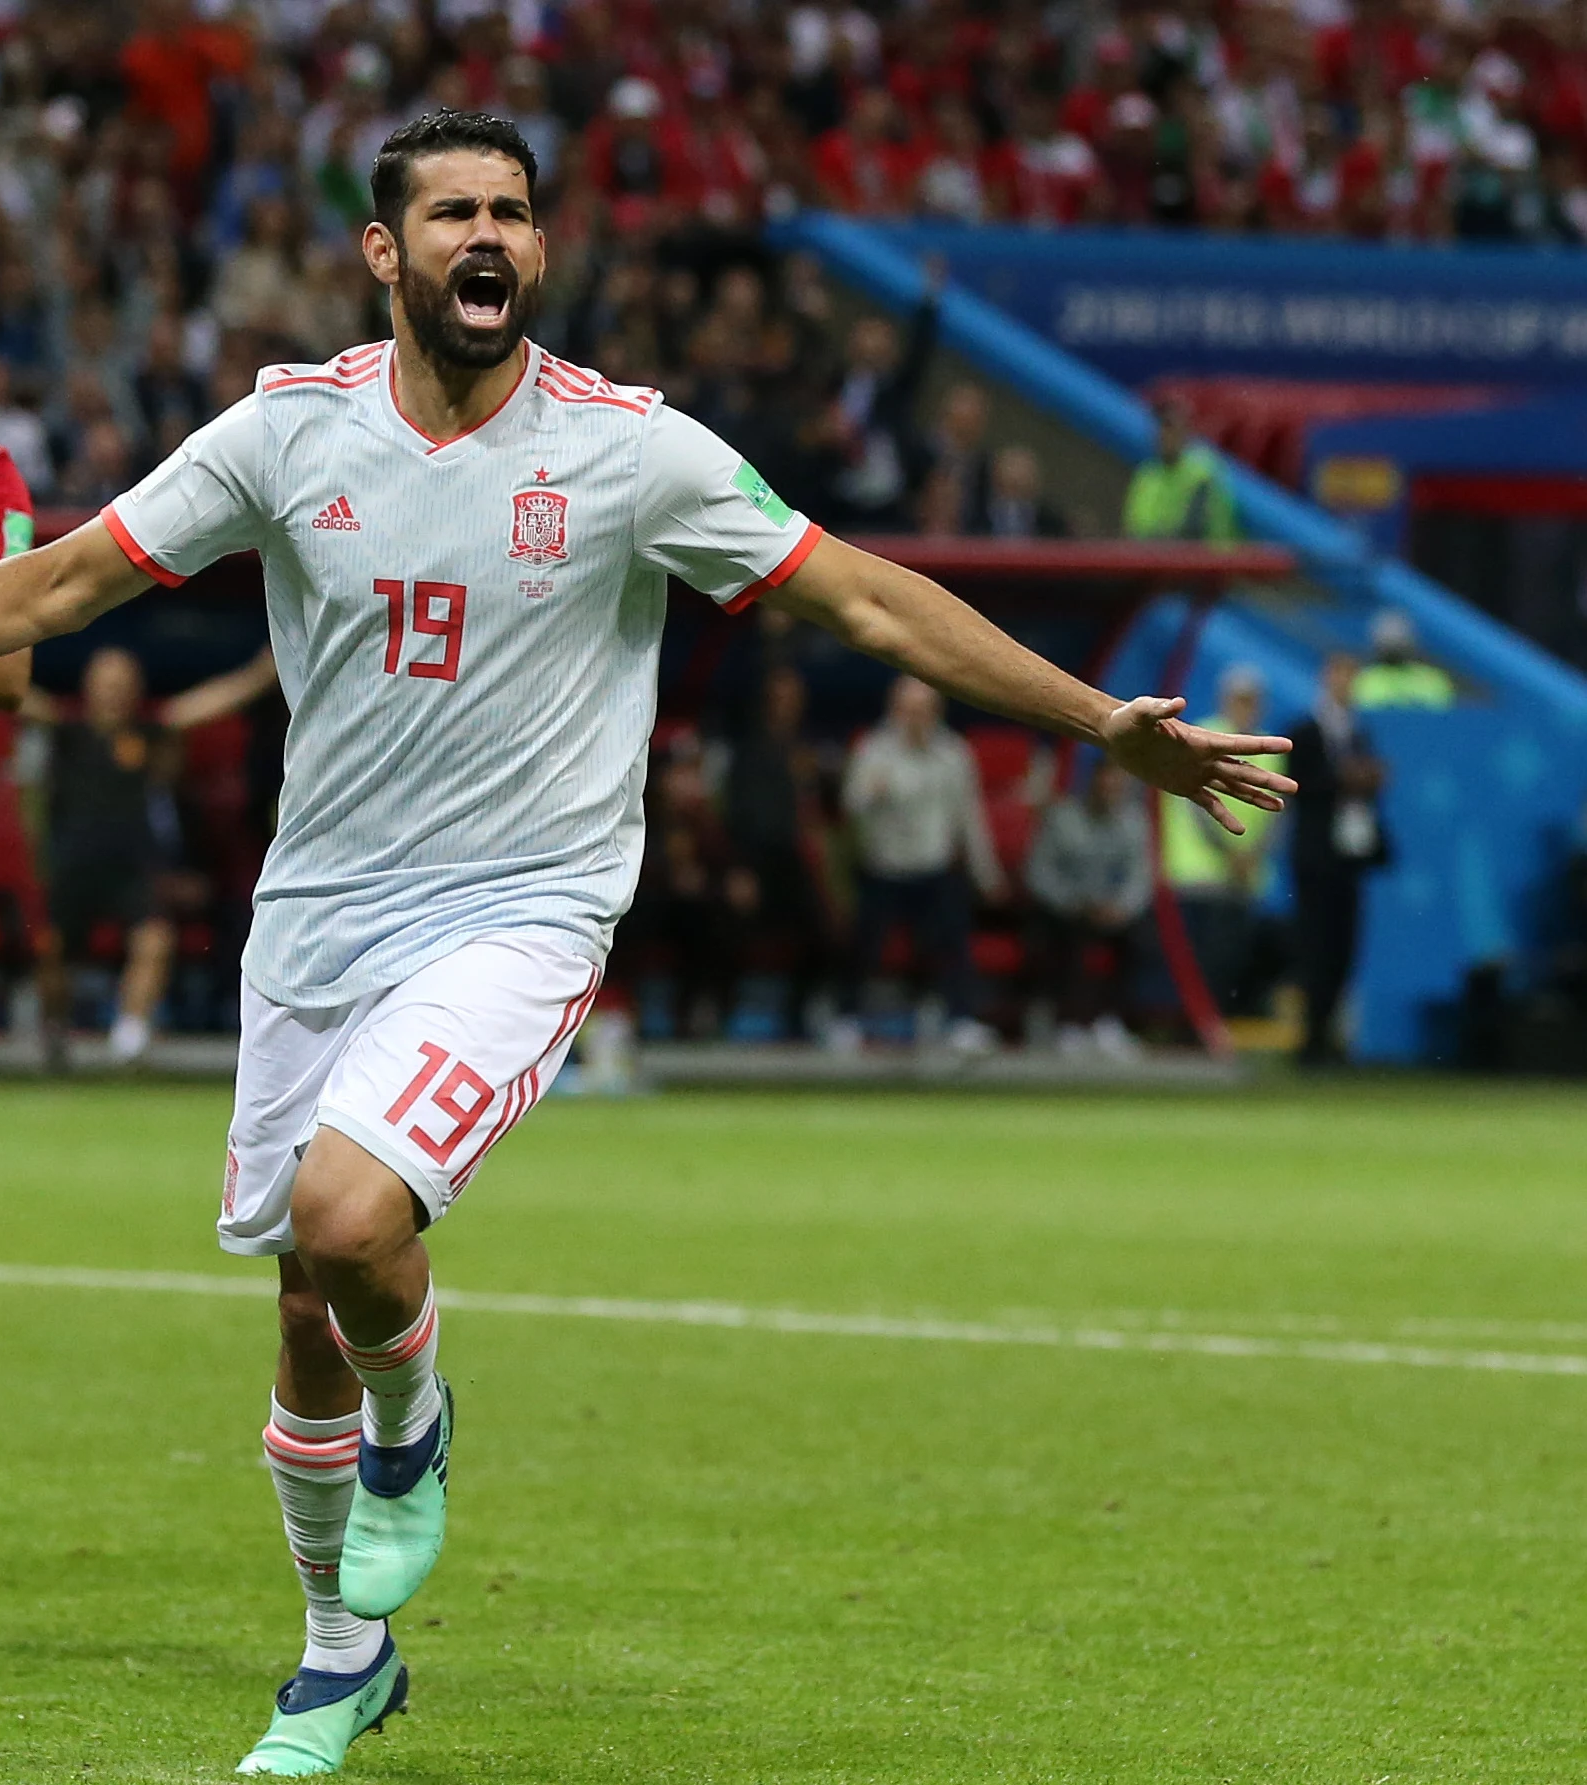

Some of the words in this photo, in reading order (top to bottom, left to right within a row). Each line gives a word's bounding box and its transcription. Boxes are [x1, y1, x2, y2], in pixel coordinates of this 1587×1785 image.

[311, 516, 361, 531] adidas
[373, 578, 467, 682] 19
[383, 1040, 495, 1168] 19
